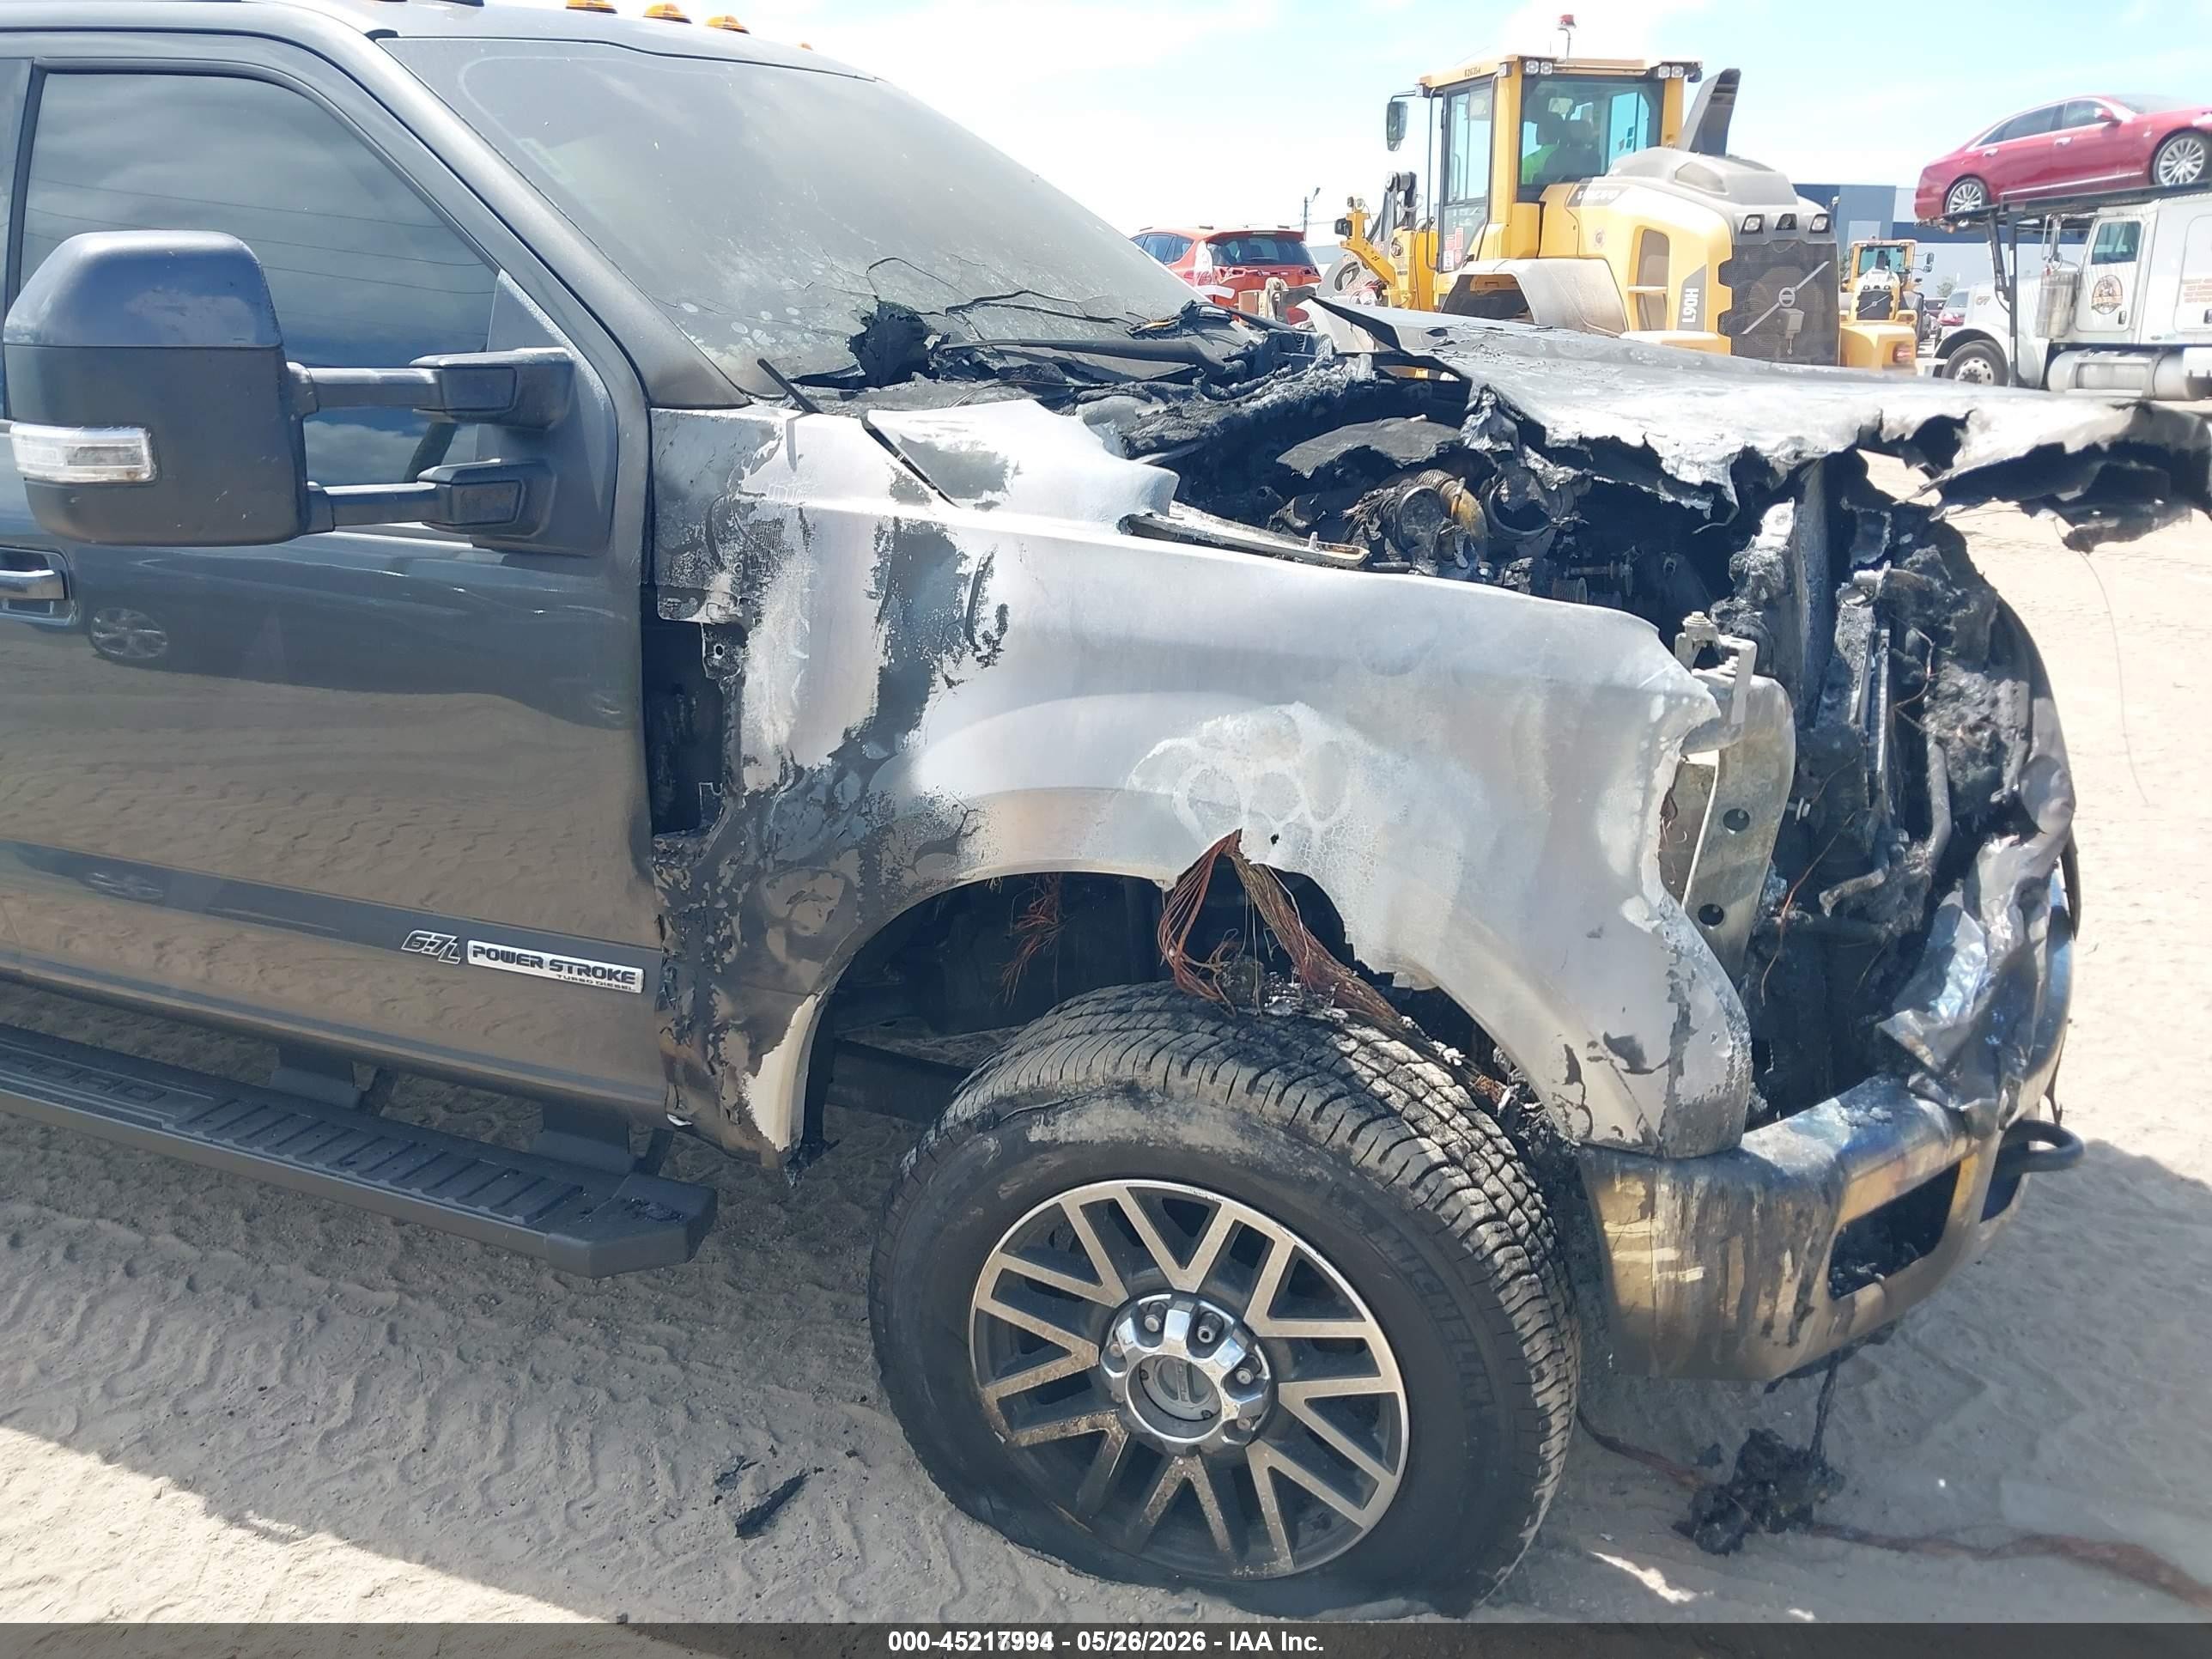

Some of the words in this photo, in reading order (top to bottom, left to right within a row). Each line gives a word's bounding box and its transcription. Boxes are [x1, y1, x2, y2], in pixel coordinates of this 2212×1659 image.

[1681, 288, 1699, 323] L90H
[473, 945, 544, 969] POWER
[550, 959, 635, 985] STROKE
[556, 974, 593, 984] TURBO
[596, 981, 633, 991] DIESEL
[1364, 1223, 1496, 1409] MICHELIN
